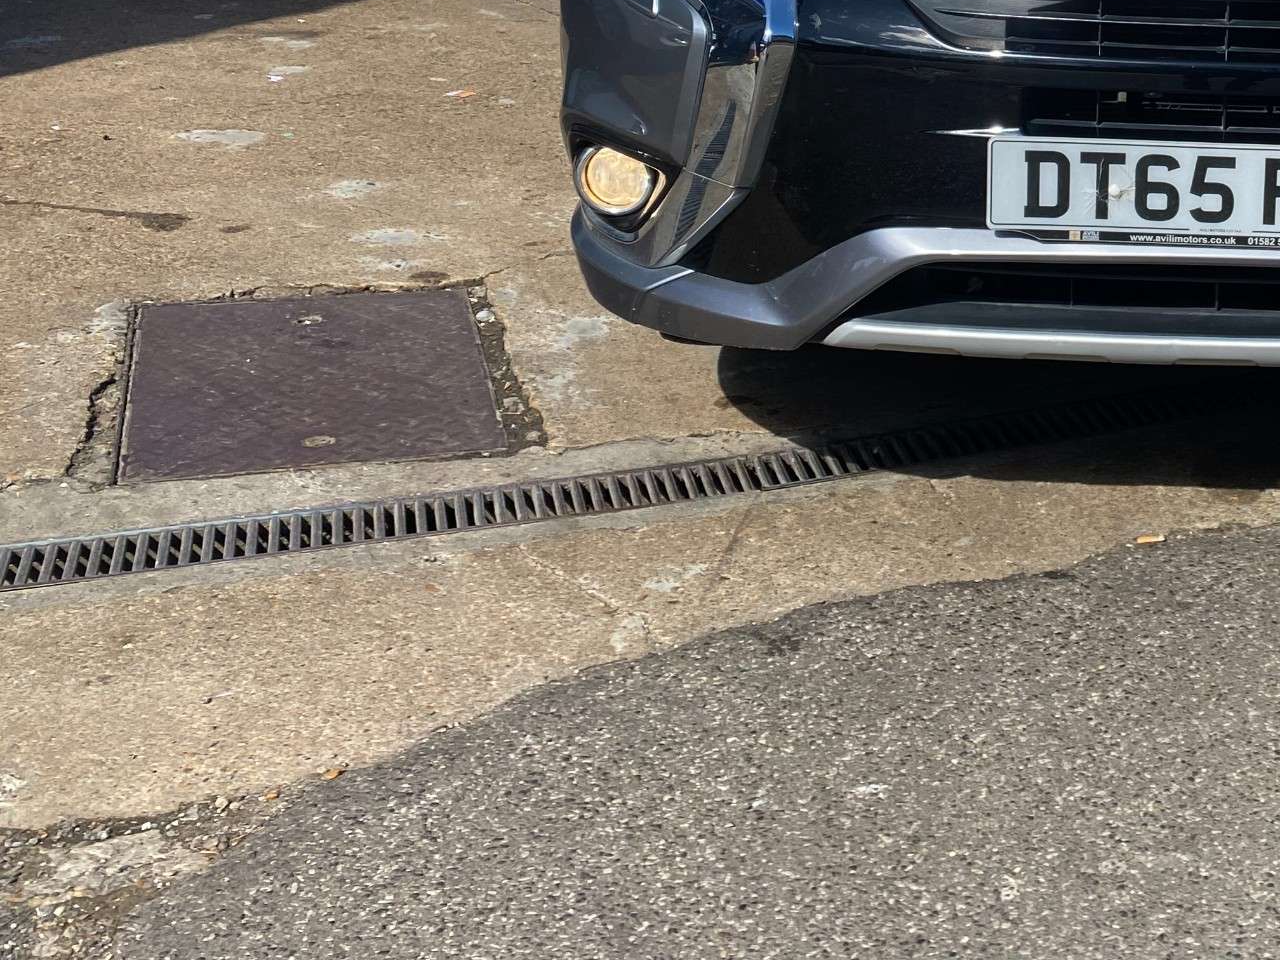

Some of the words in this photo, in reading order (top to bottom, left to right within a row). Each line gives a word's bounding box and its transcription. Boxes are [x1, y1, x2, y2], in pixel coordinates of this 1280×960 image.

[1023, 149, 1237, 223] DT65
[1129, 234, 1236, 245] www.avilimotors.co.uk
[1247, 237, 1275, 246] 01582
